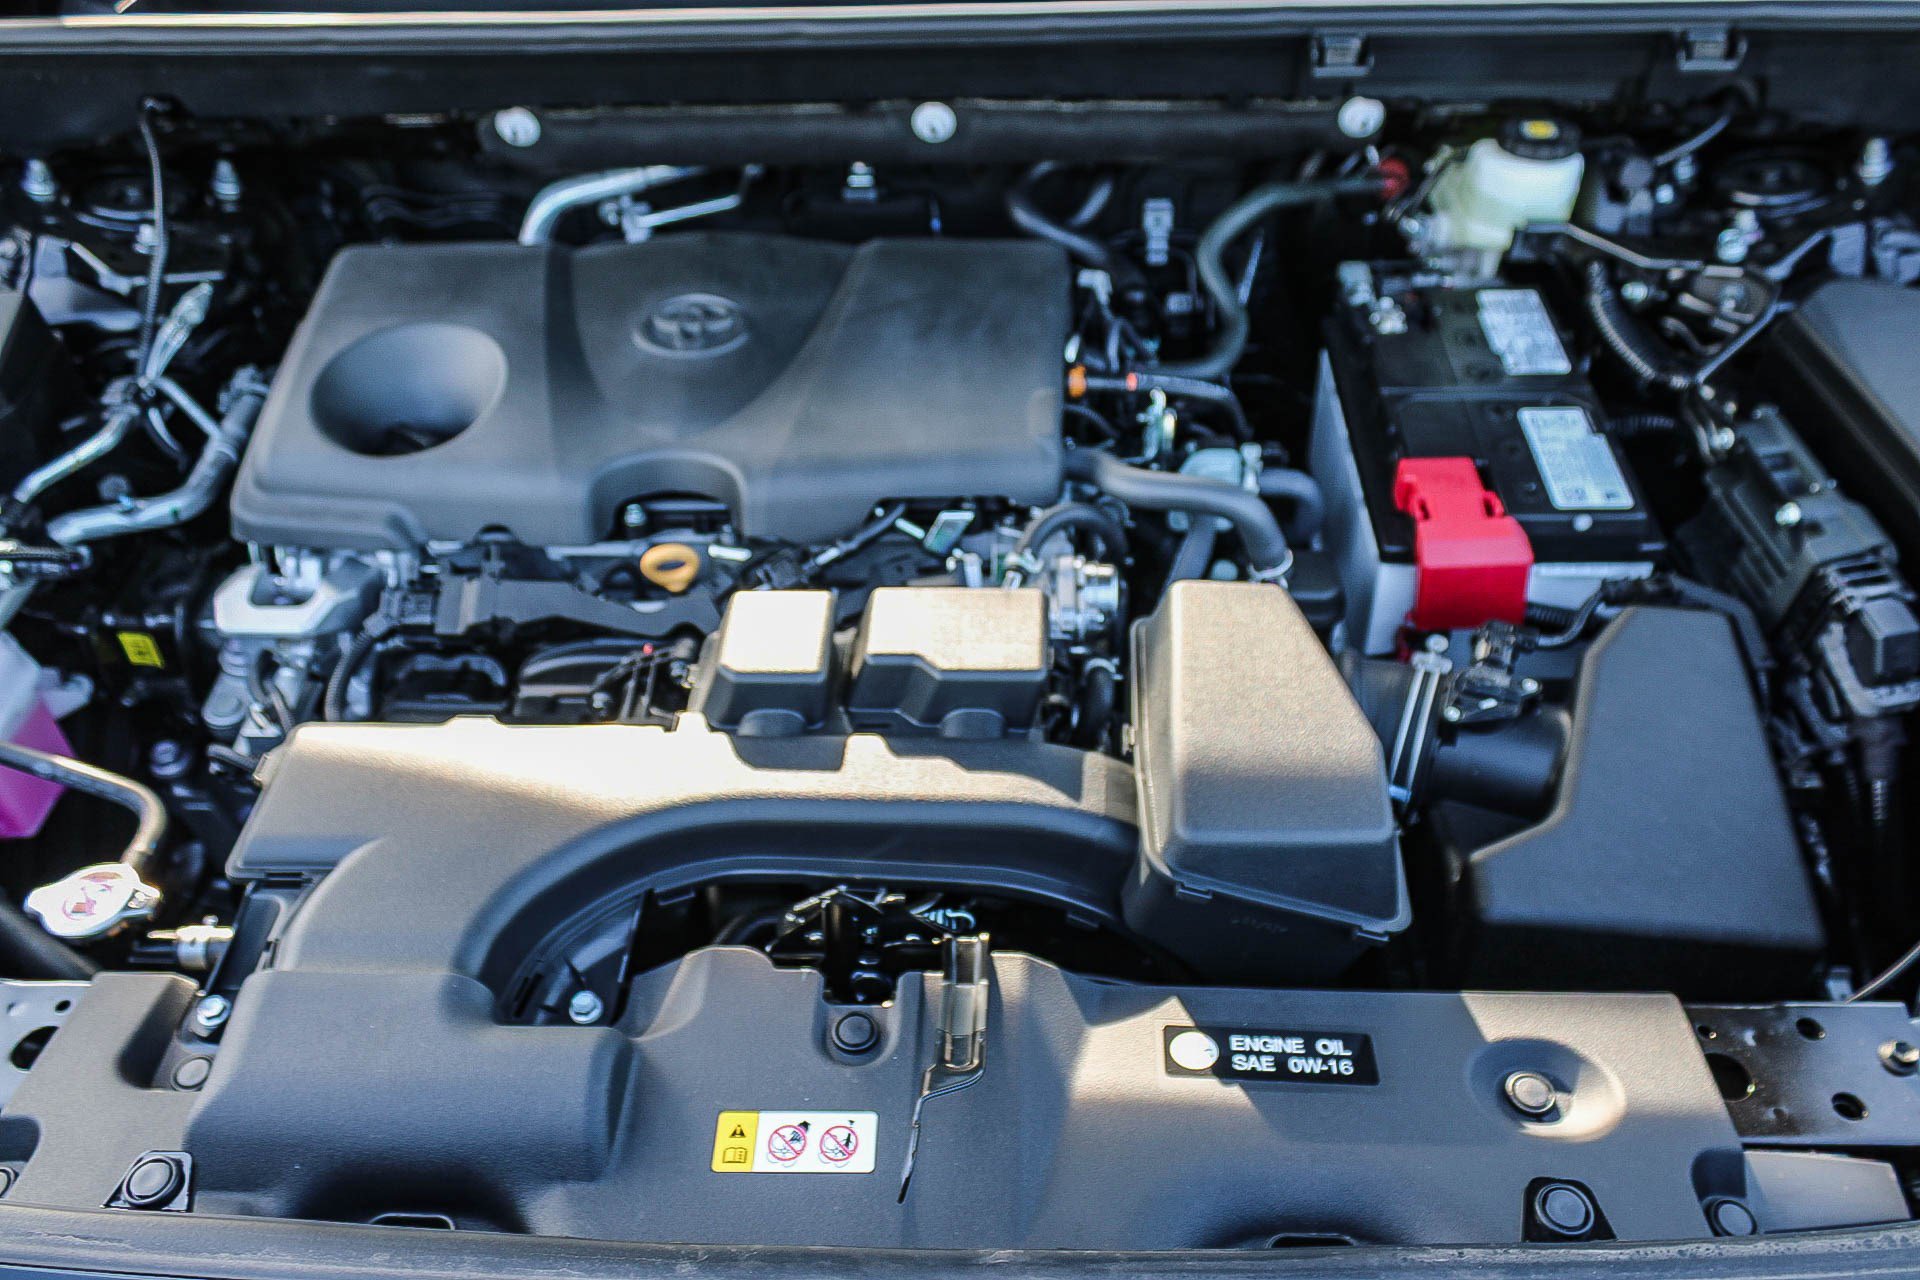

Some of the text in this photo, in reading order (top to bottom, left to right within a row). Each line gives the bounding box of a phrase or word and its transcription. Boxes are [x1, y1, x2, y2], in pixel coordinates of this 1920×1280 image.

[1229, 1035, 1352, 1056] ENGINE OIL
[1231, 1055, 1353, 1075] SAE 0W-16
